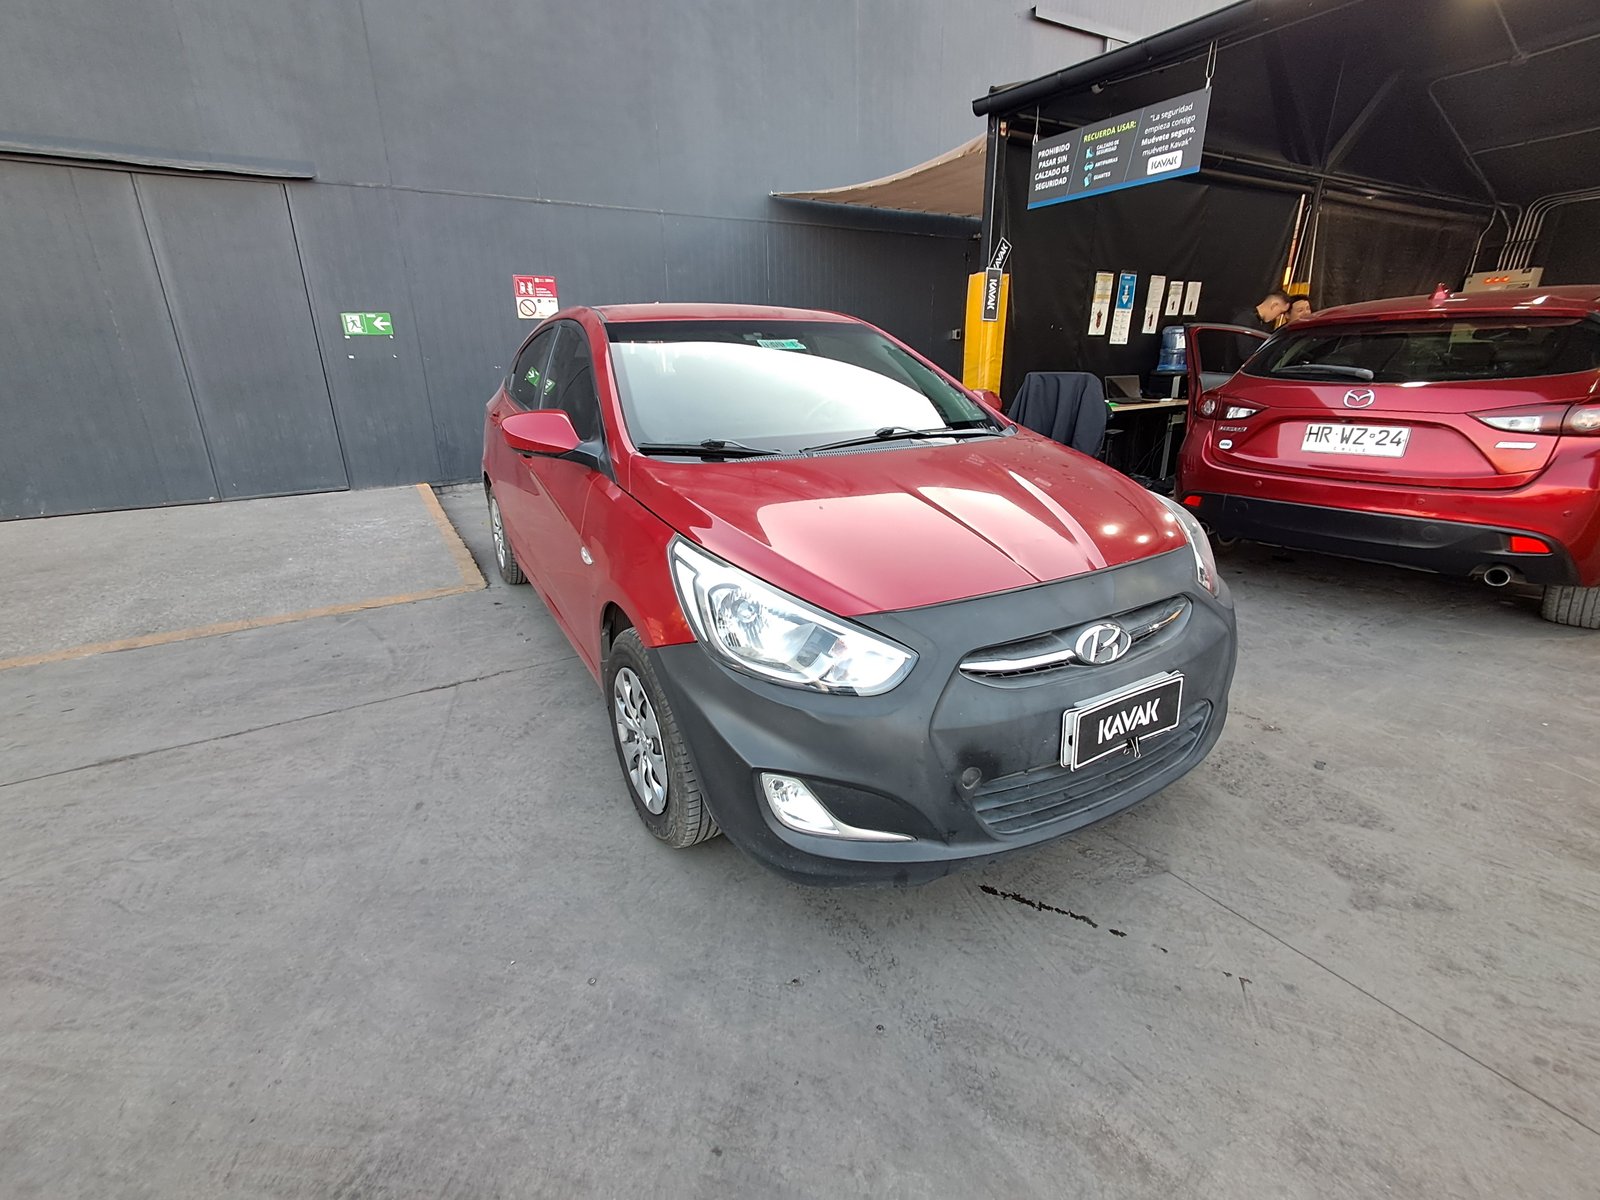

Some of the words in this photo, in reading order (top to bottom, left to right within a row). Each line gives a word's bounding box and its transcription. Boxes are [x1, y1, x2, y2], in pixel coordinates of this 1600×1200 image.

[1161, 102, 1193, 119] seguridad
[1083, 126, 1116, 142] RECUERDA
[1117, 120, 1137, 133] USAR:
[1144, 122, 1170, 135] empieza
[1171, 114, 1196, 127] contigo
[1141, 133, 1170, 146] Muévete
[1170, 126, 1196, 139] seguro,
[1037, 143, 1070, 159] PROHIBIDO
[1142, 144, 1169, 157] muévete
[1038, 157, 1056, 169] PASAR
[1057, 154, 1068, 164] SIN
[1150, 155, 1178, 170] KAVAK
[1034, 168, 1060, 181] CALZADO
[1061, 165, 1070, 174] DE
[1034, 177, 1067, 191] SEGURIDAD
[986, 279, 998, 310] KAVAK
[1098, 698, 1160, 744] KAVAK
